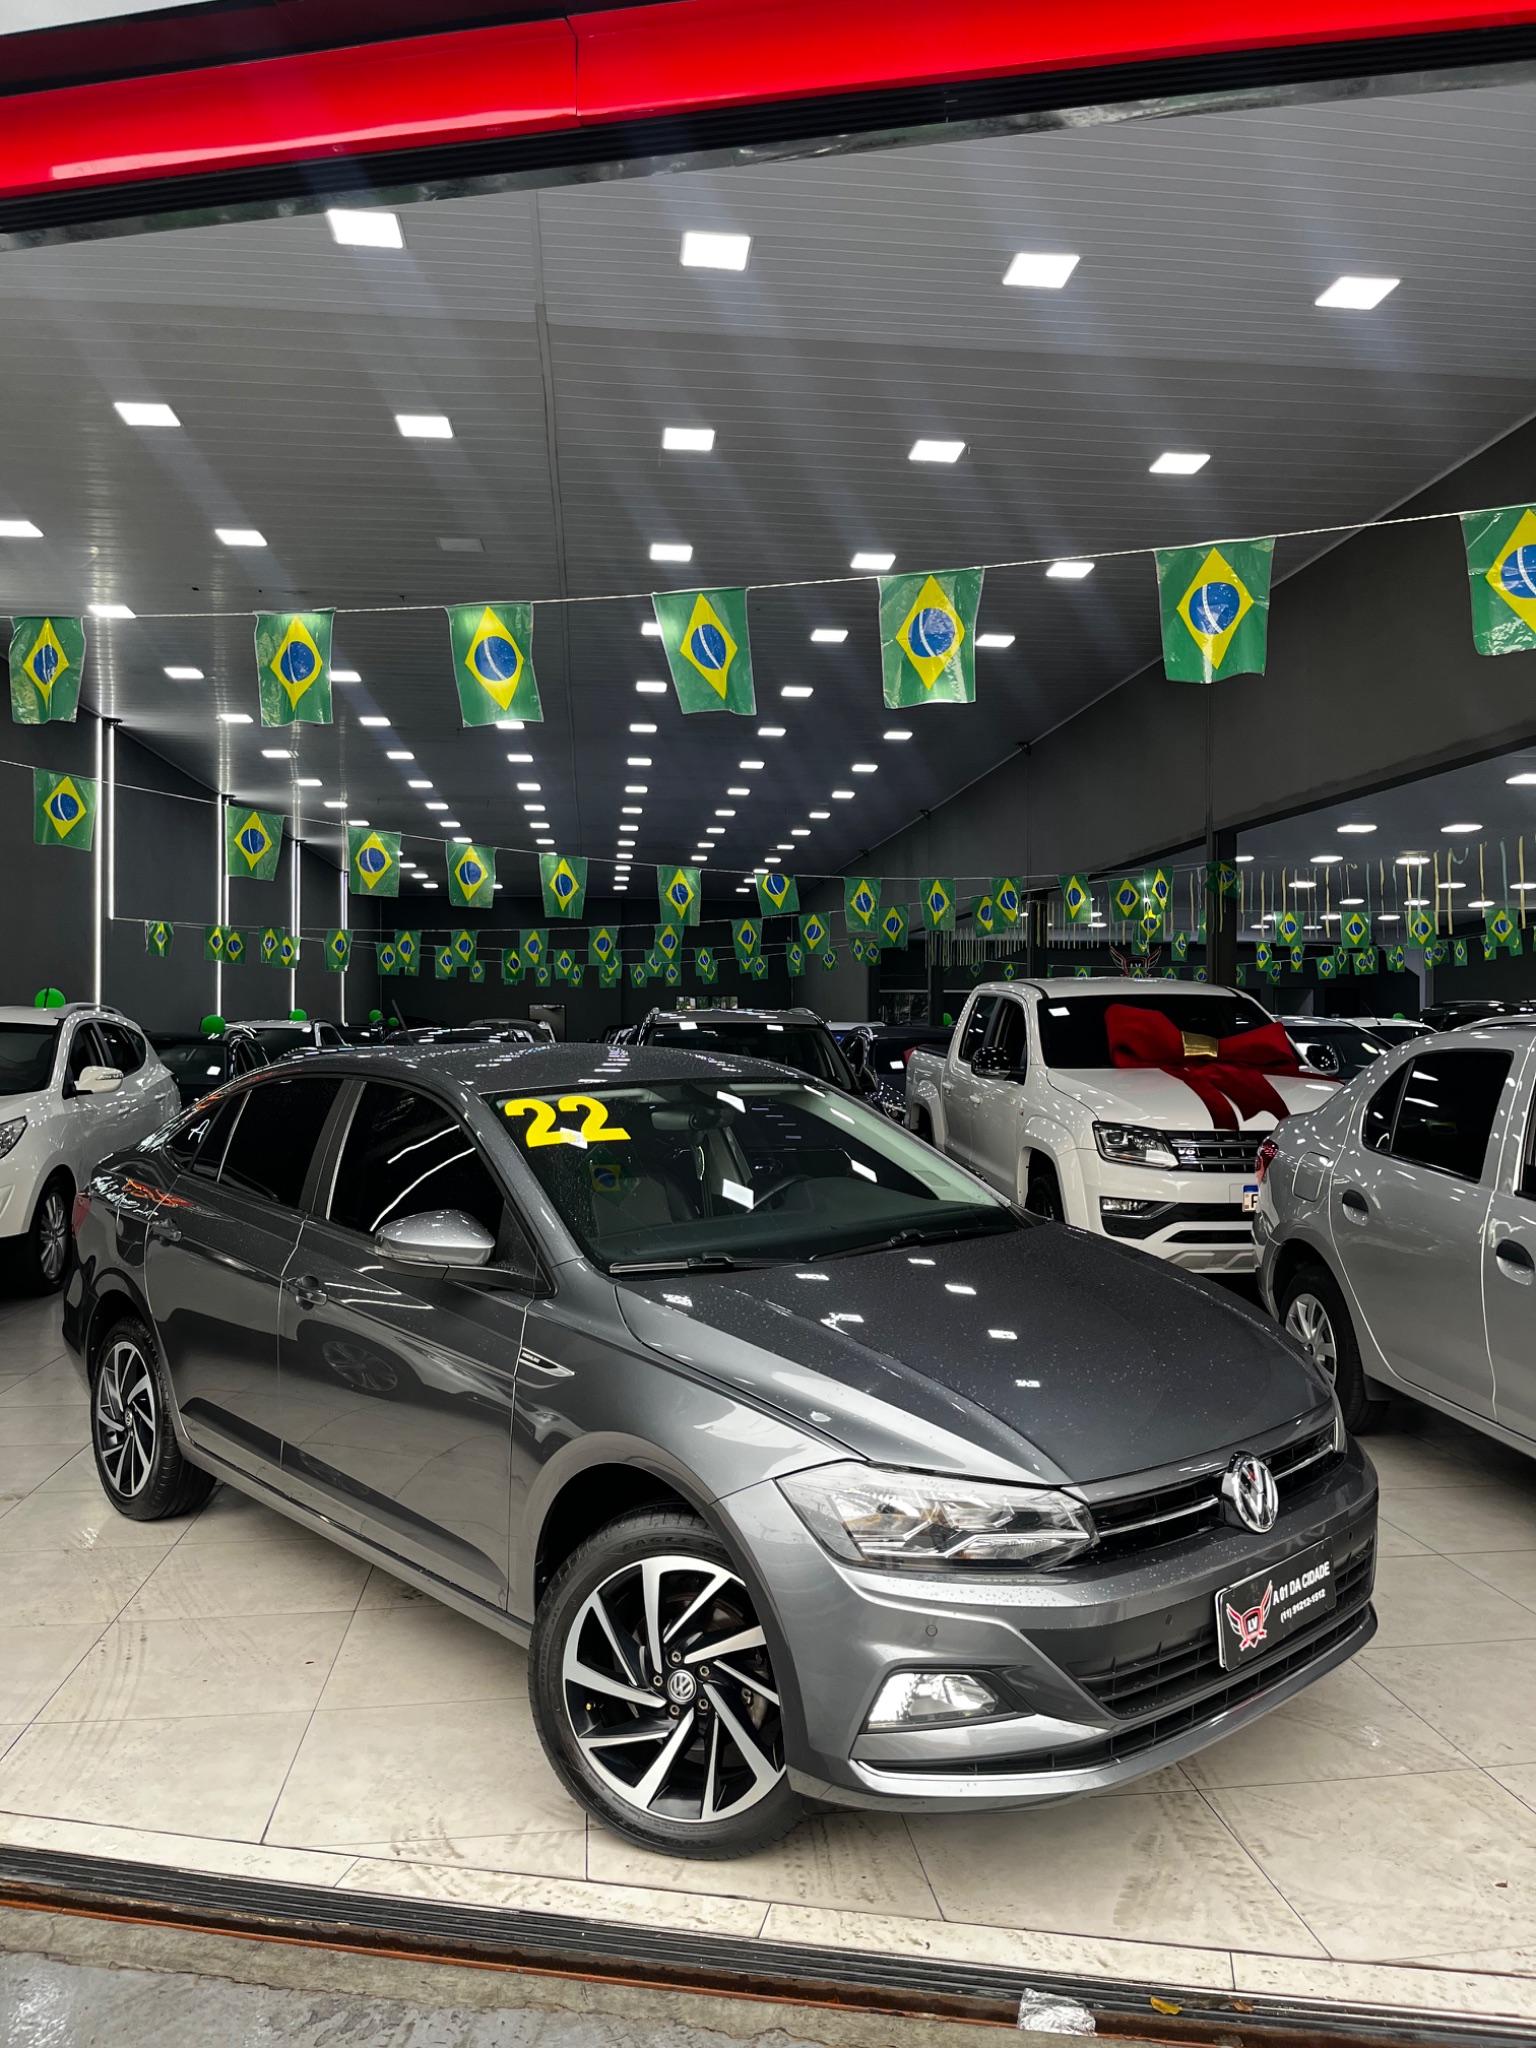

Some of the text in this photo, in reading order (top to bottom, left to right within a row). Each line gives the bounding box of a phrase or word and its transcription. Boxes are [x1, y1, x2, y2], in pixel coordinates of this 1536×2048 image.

[504, 1095, 631, 1148] 22
[1177, 1147, 1196, 1156] V6
[1272, 1561, 1330, 1606] A 01 DA CIDADE
[1247, 1616, 1258, 1633] LV
